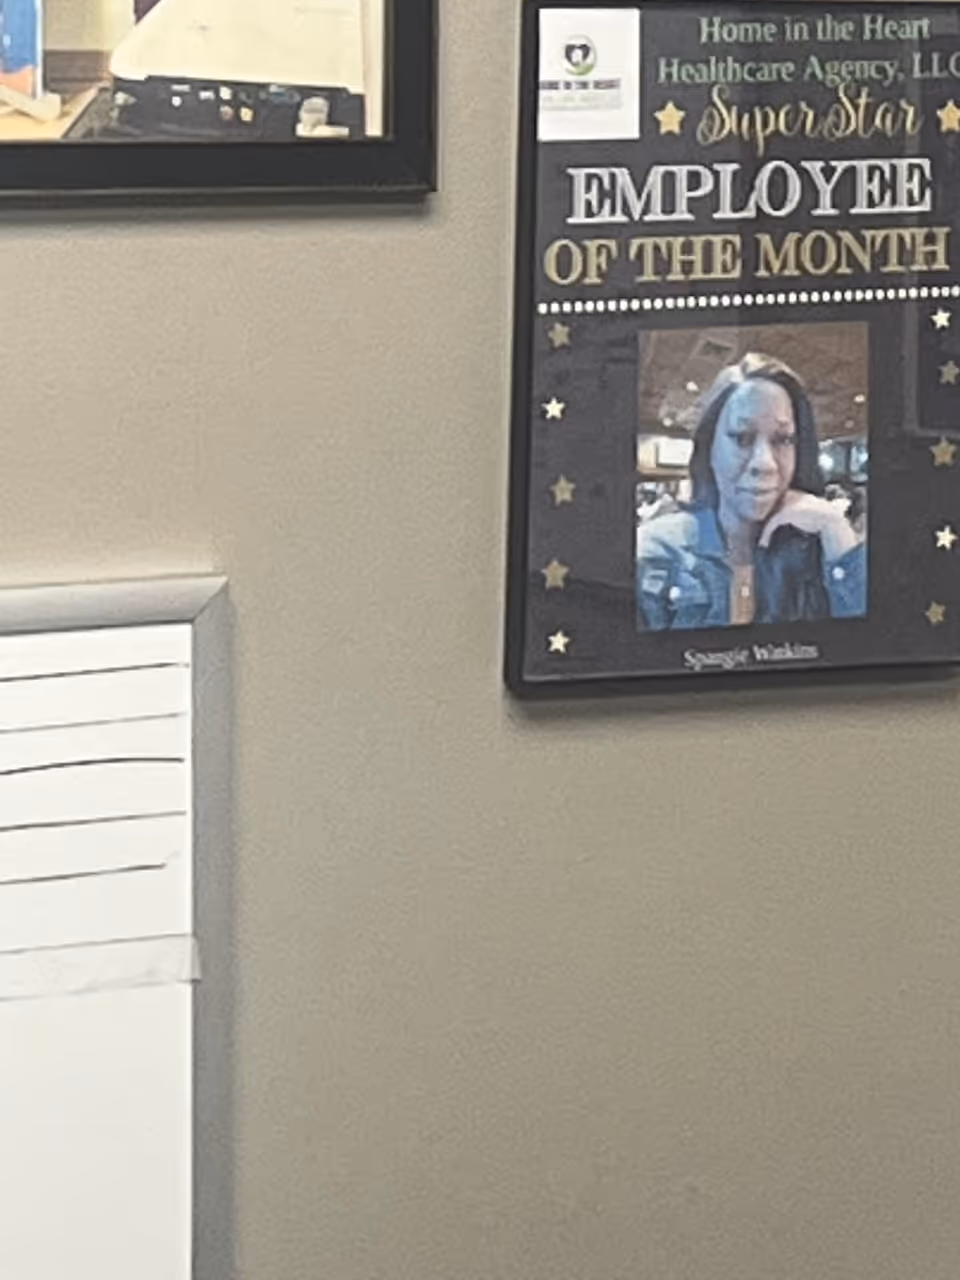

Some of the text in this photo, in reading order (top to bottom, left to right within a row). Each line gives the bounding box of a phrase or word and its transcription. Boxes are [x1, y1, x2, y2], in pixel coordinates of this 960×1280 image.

[700, 13, 930, 43] Home in the Heart
[657, 56, 795, 83] Healthcare
[696, 80, 922, 157] Super Star
[565, 158, 932, 224] EMPLOYEE
[544, 226, 951, 285] OF THE MONTH
